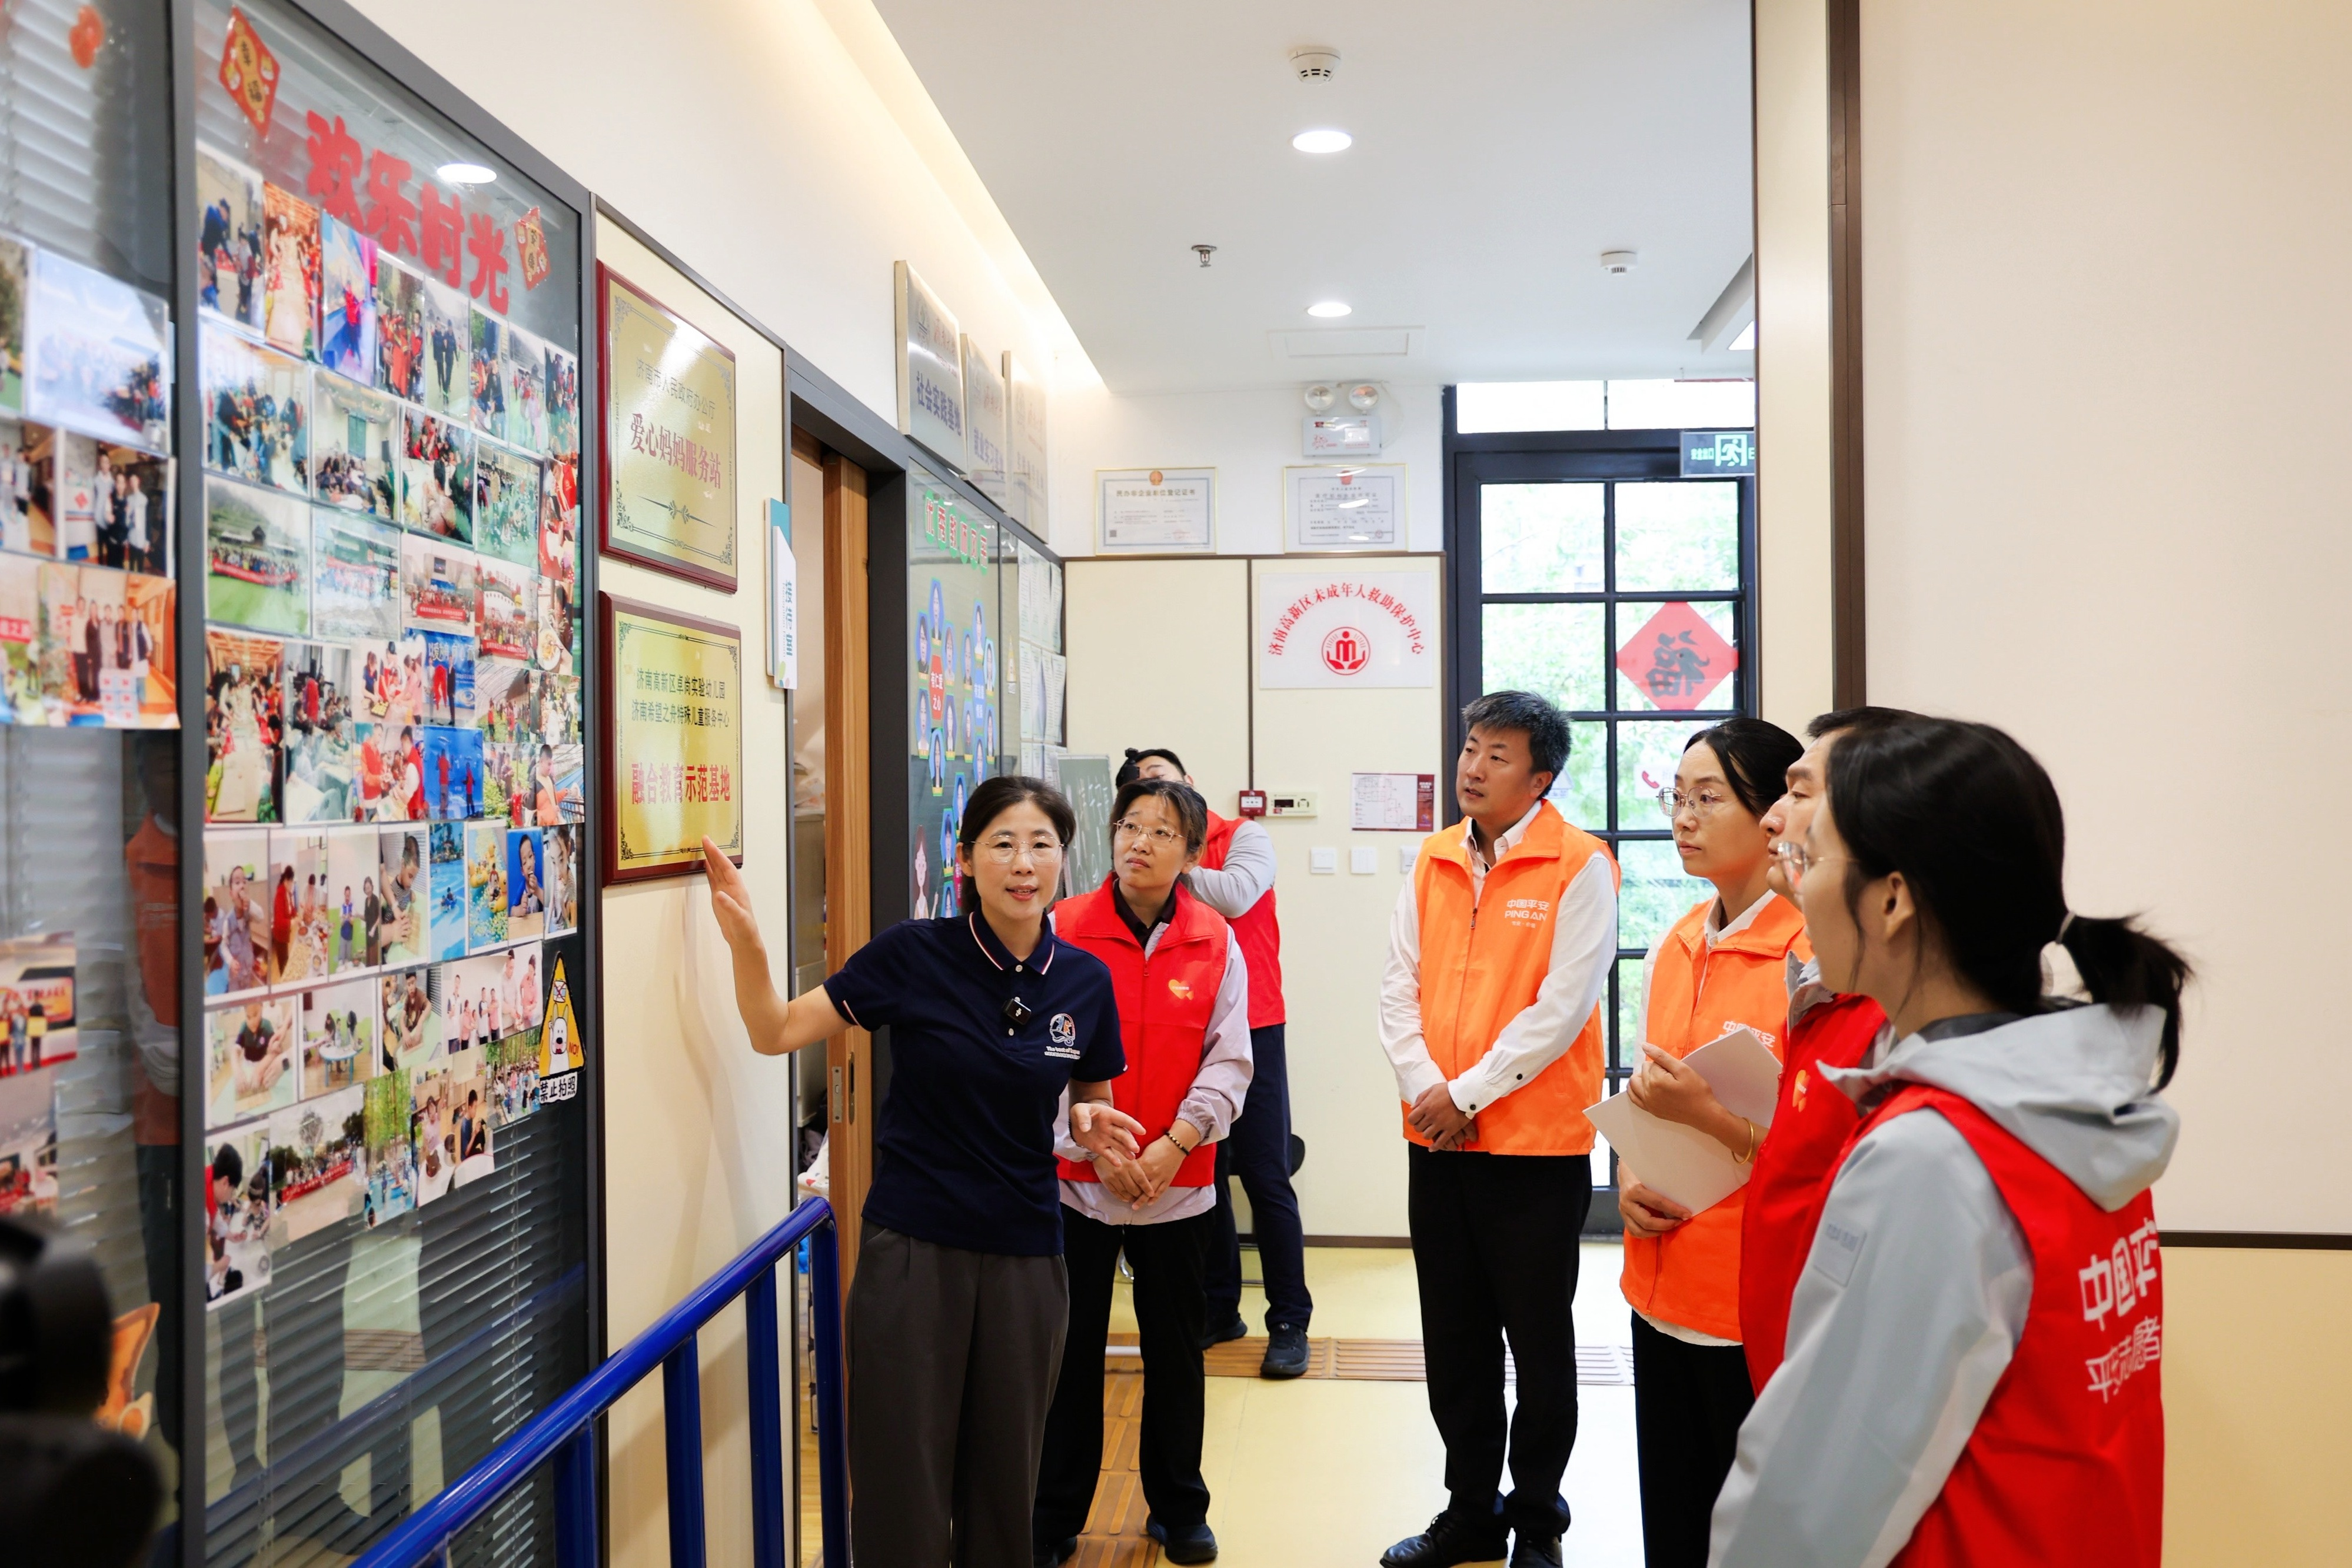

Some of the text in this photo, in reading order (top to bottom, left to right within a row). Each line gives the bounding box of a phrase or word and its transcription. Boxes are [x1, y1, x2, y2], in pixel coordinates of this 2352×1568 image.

[305, 109, 510, 316] 欢乐时光
[630, 412, 721, 490] 爱心妈妈服务站
[1268, 582, 1425, 656] 济南高新区未成年人救助保护中心
[631, 698, 730, 728] 济南希望之舟特殊儿童服务中心
[631, 761, 731, 805] 融合教育示范基地
[1506, 898, 1550, 911] 中国平安
[568, 1041, 580, 1058] NO!
[540, 1077, 577, 1102] 禁止拍照
